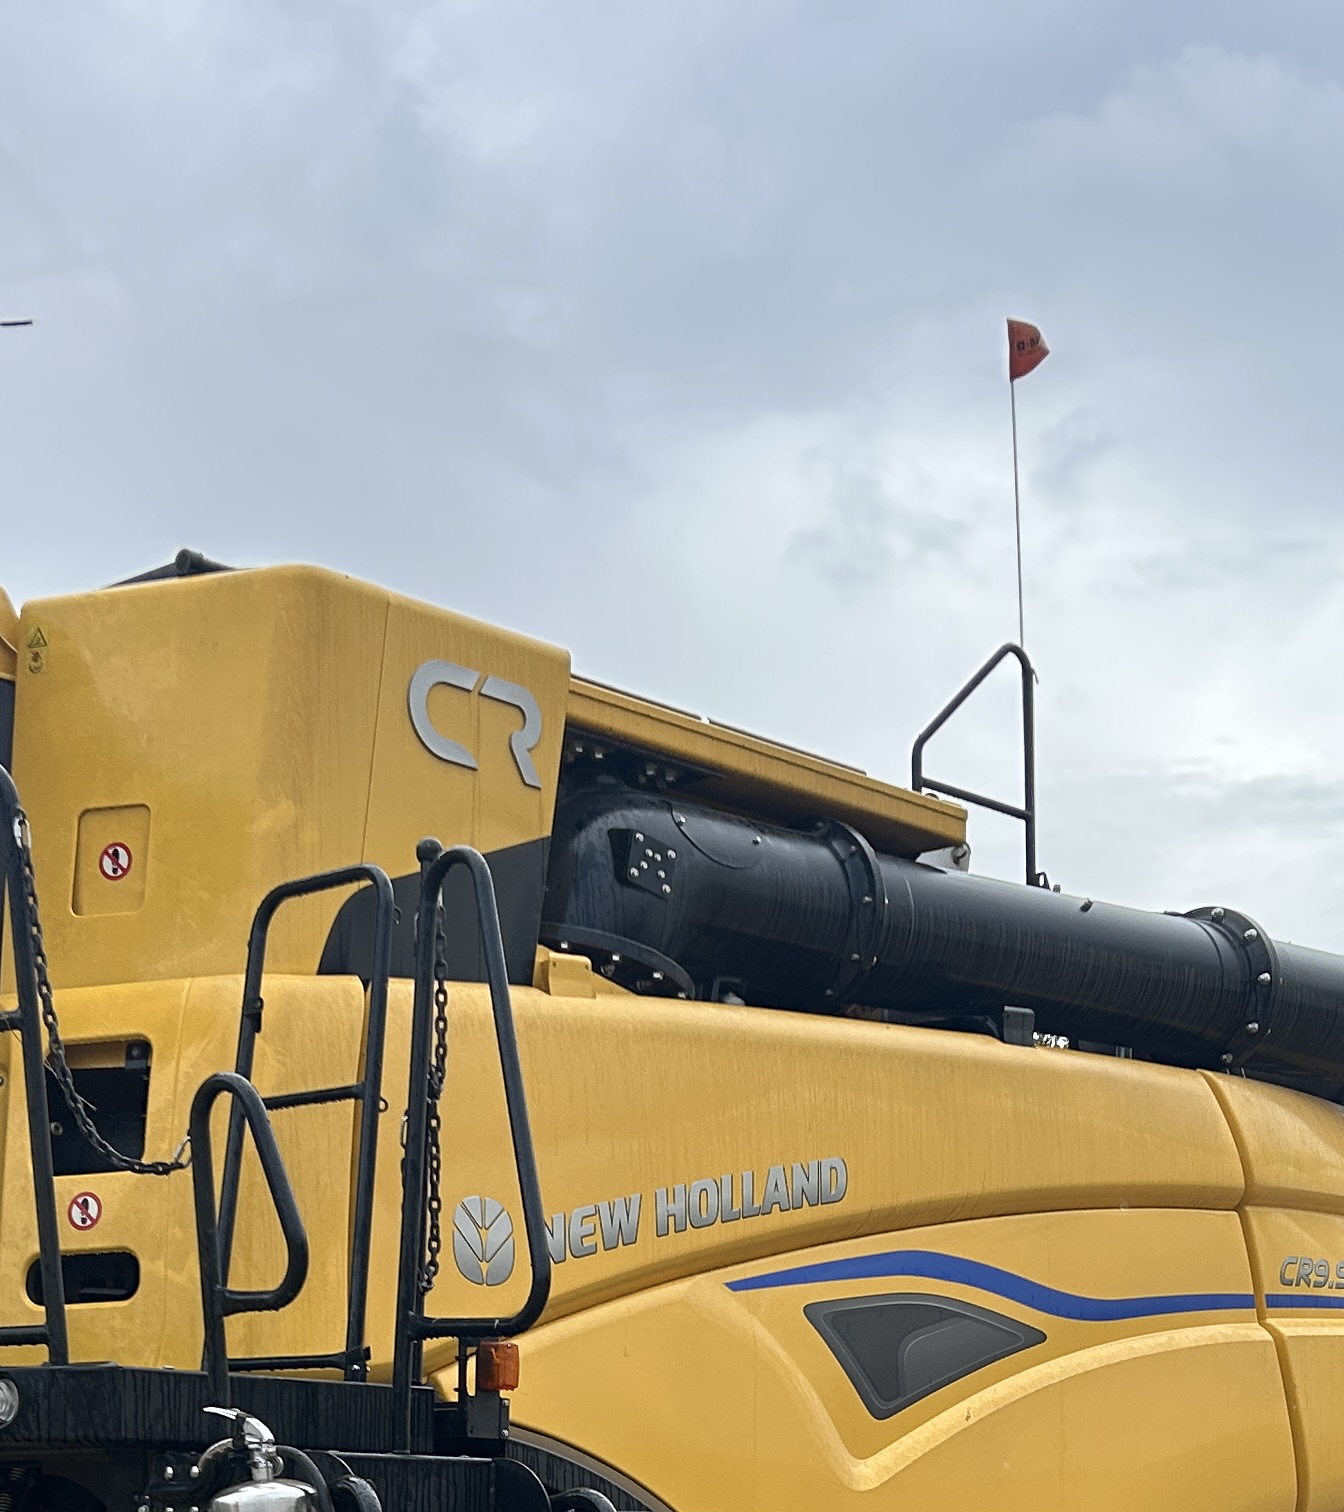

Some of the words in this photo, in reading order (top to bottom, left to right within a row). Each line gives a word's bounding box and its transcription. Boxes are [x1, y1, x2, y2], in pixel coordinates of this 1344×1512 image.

[407, 658, 543, 790] CR
[544, 1192, 643, 1265] NEW
[655, 1156, 849, 1239] HOLLAND
